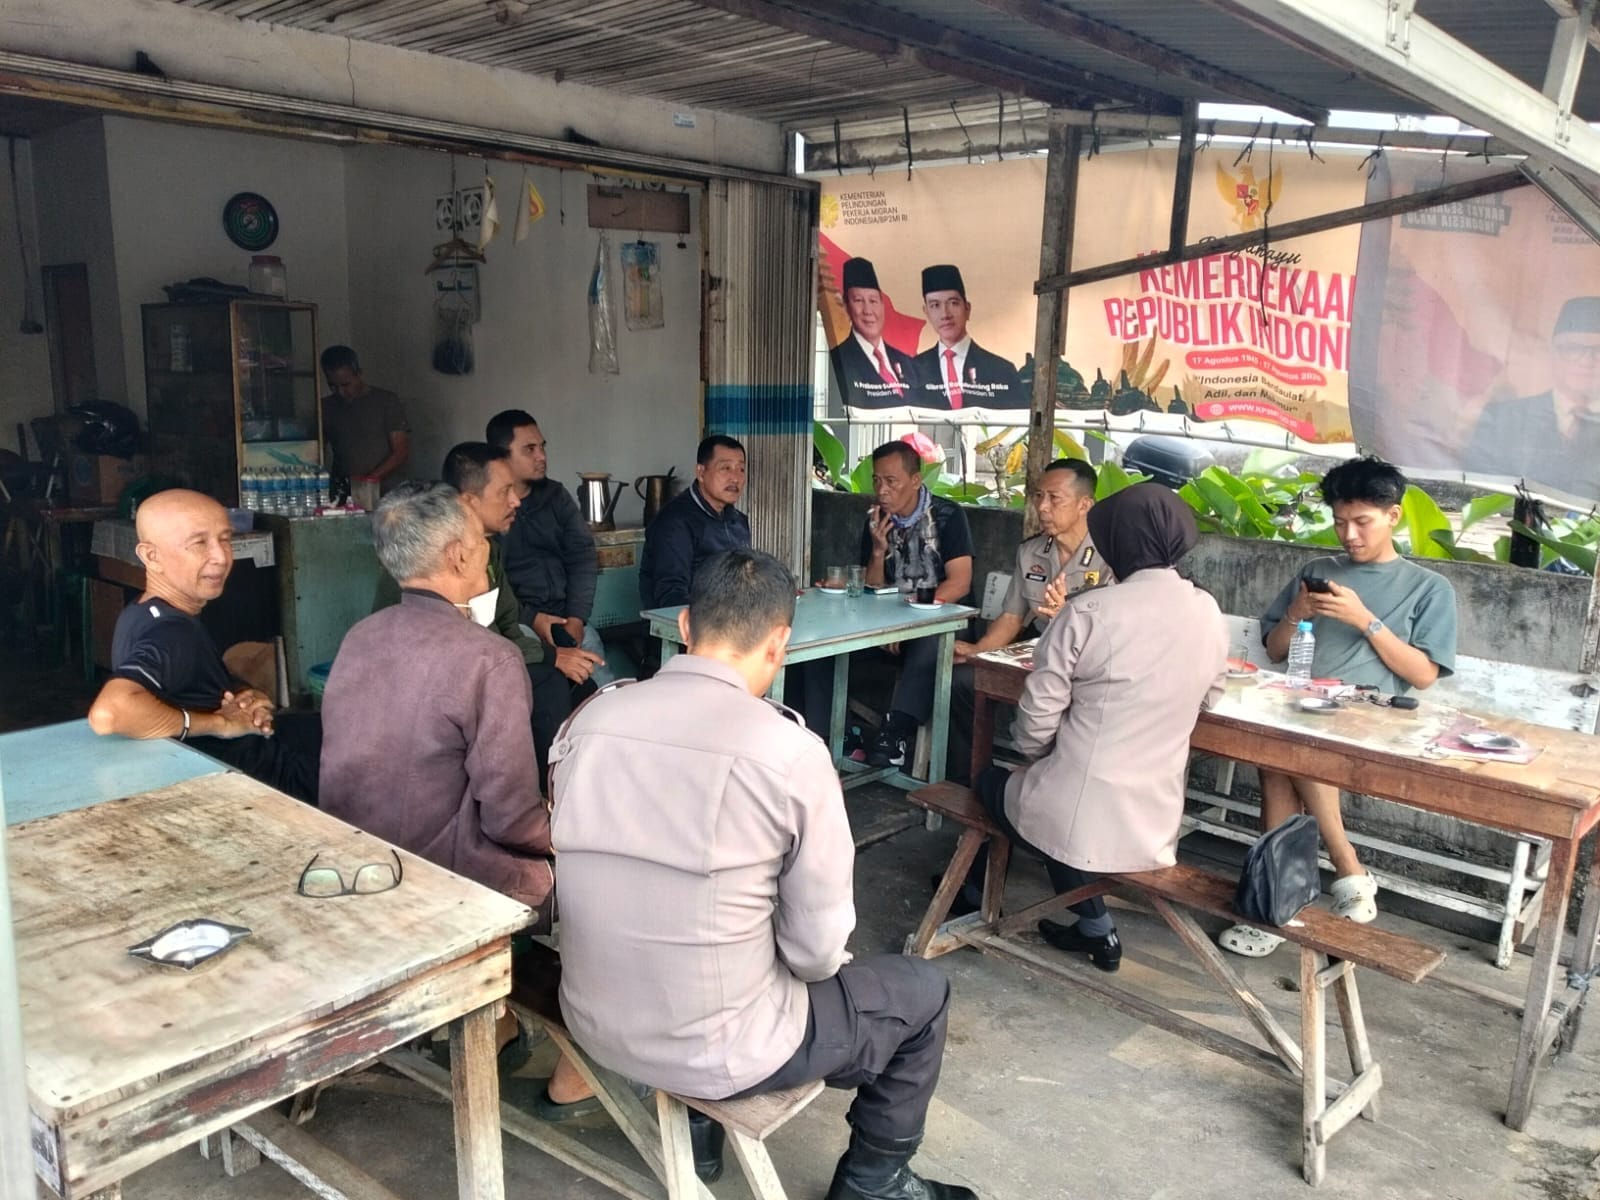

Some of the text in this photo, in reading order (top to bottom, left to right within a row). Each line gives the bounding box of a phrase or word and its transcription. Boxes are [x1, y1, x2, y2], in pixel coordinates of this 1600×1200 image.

[840, 191, 885, 200] KEMENTERIAN
[842, 206, 898, 217] PEKERJA MIGRAN
[1103, 297, 1245, 347] REPUBLIK
[1204, 355, 1239, 366] Agustus
[1195, 373, 1259, 385] "Indonesia
[1204, 389, 1232, 399] Adil,
[1234, 388, 1257, 398] dan
